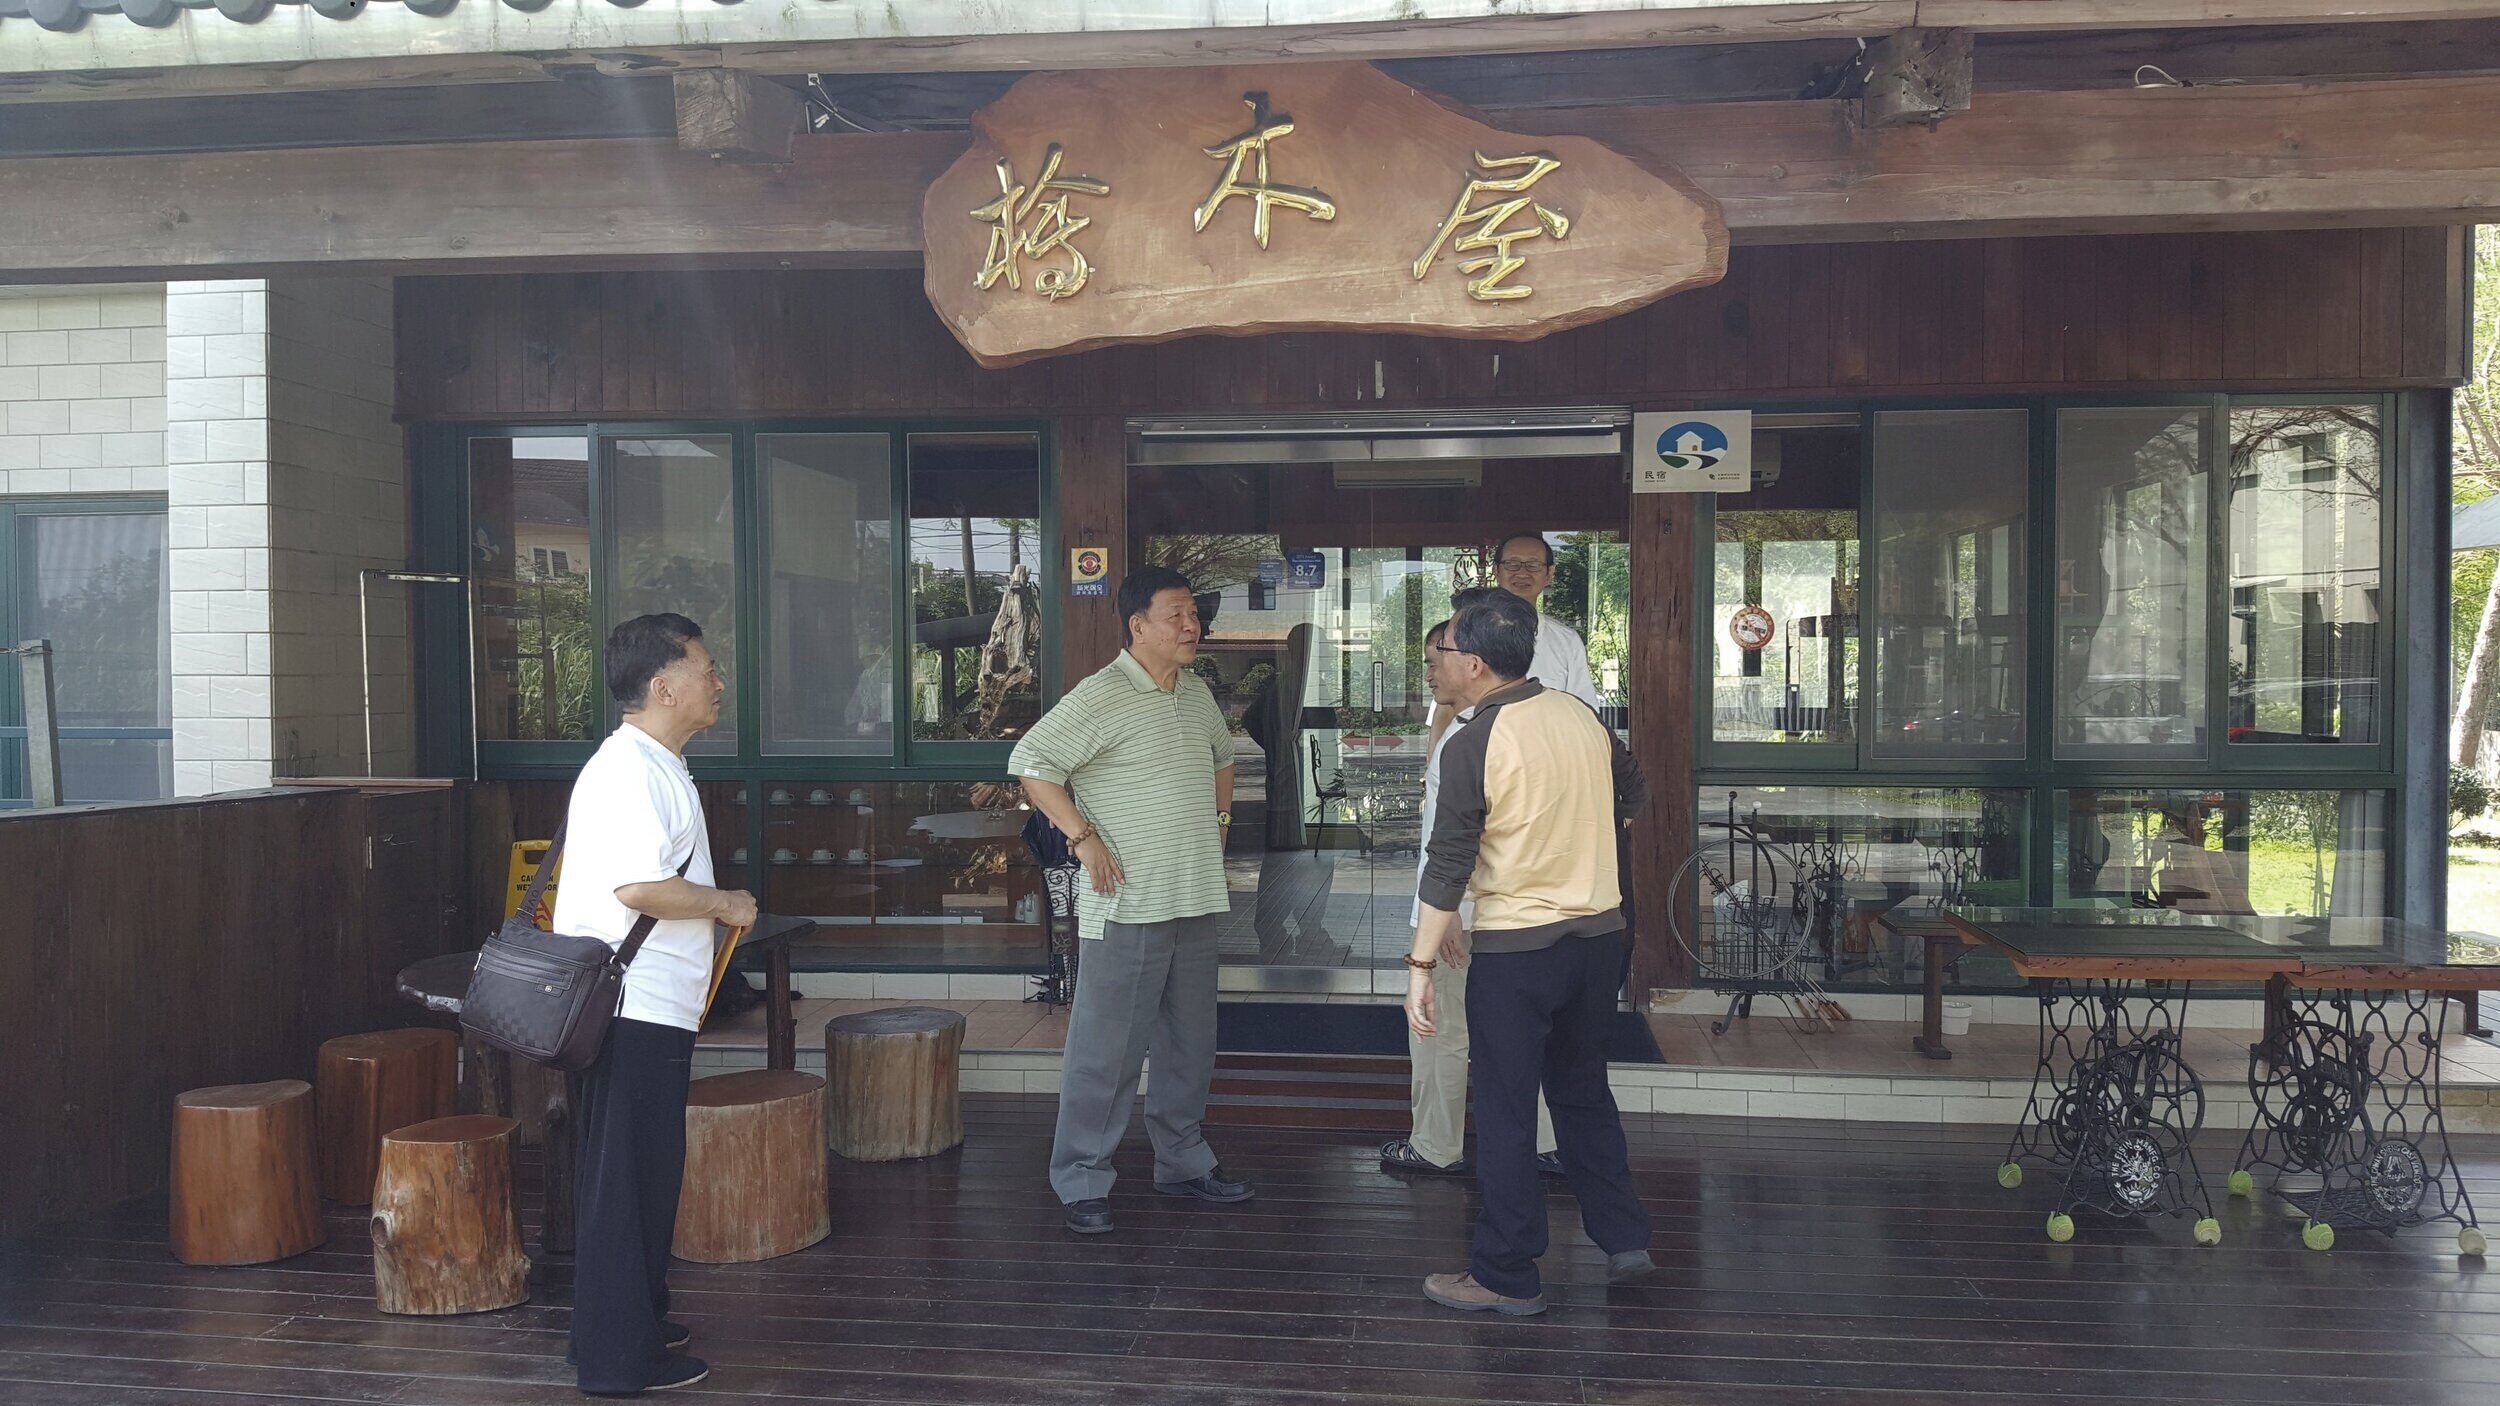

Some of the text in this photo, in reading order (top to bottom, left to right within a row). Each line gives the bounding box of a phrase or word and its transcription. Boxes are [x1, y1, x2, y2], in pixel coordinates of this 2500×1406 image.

[1644, 470, 1667, 480] 民宿
[1295, 564, 1317, 577] 8.7
[520, 874, 555, 883] CAUN
[2111, 1161, 2120, 1177] THE
